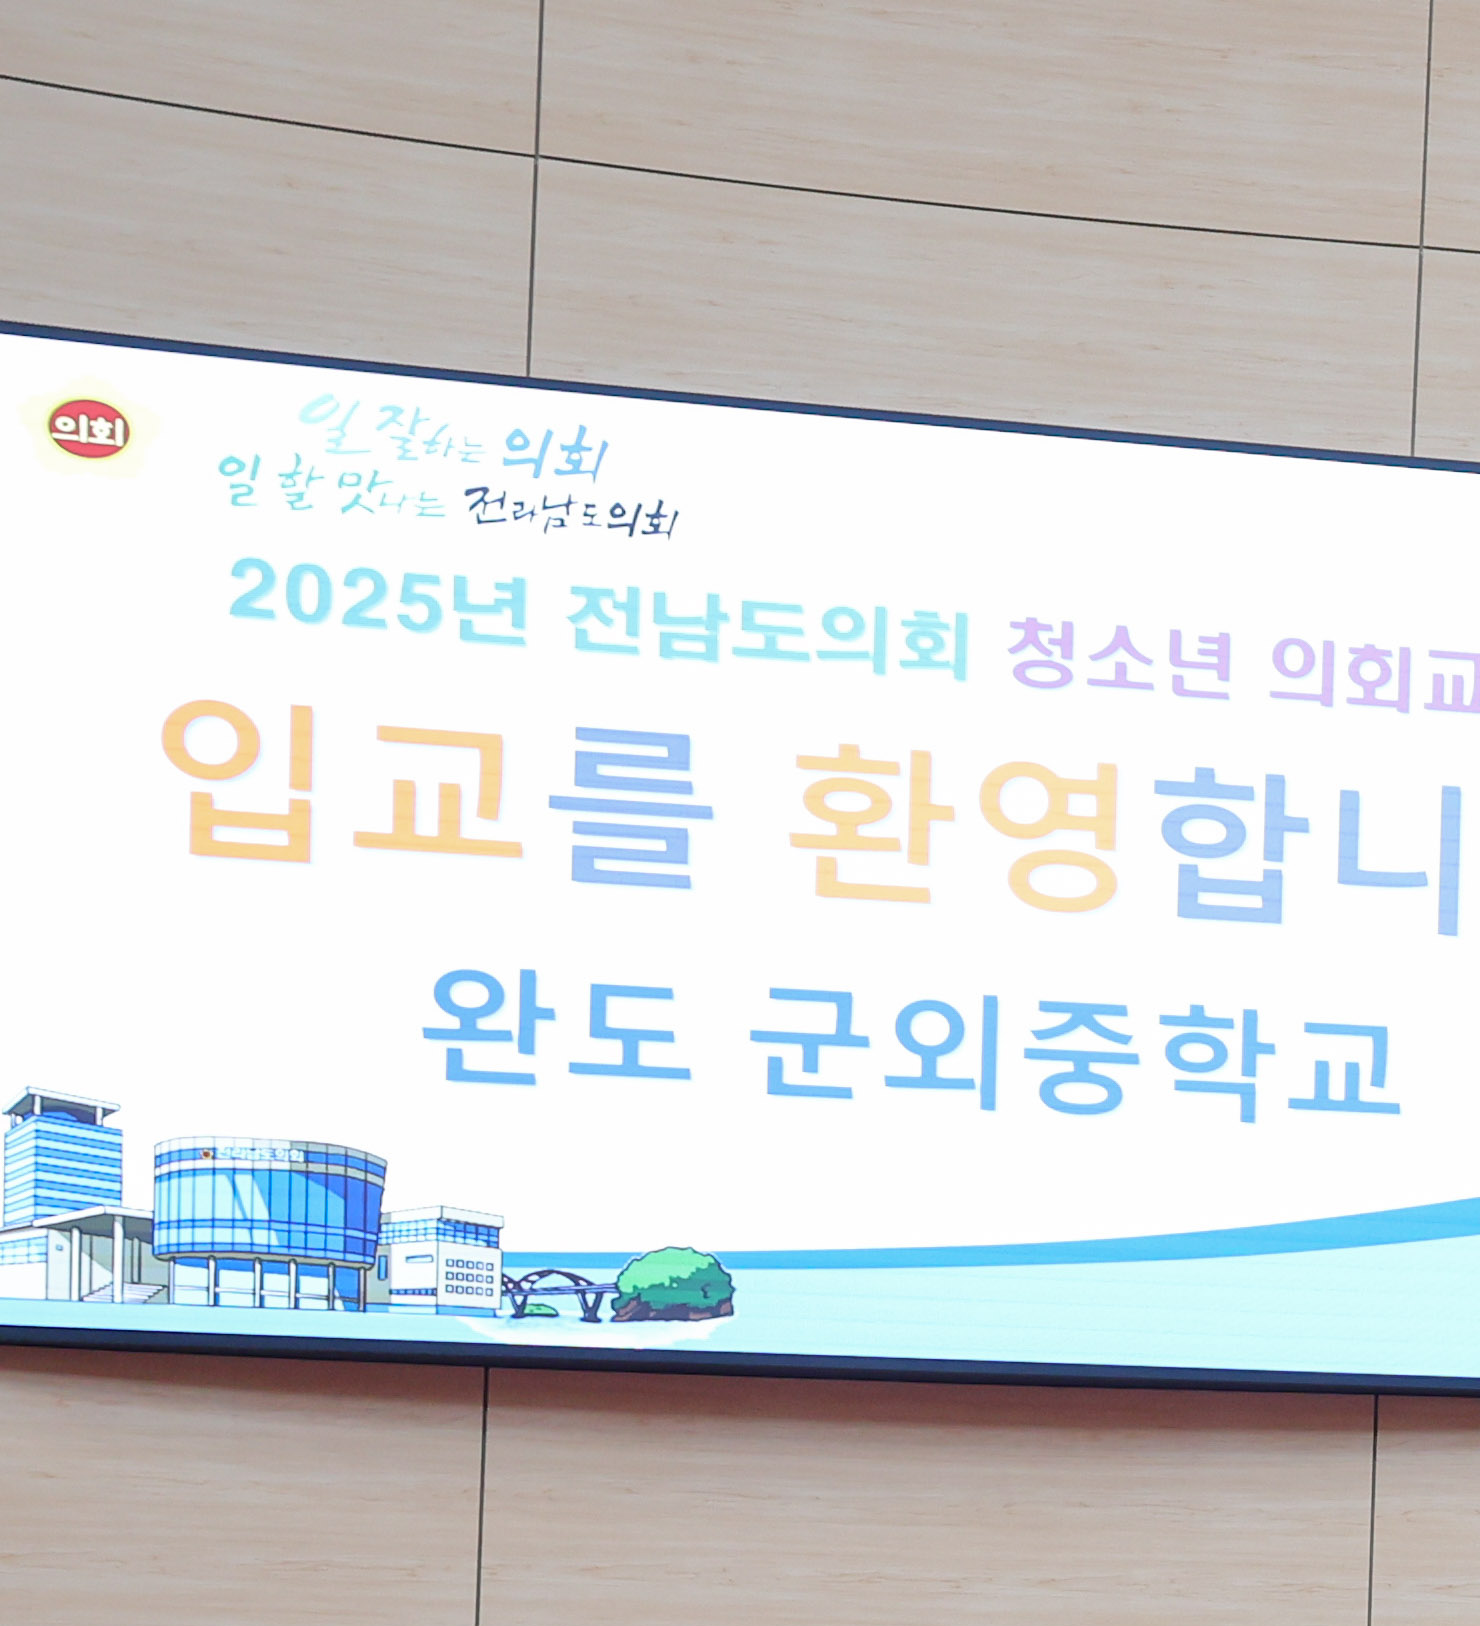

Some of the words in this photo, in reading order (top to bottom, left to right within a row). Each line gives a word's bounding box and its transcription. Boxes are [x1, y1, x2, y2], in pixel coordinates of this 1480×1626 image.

[50, 410, 127, 450] 의회
[298, 394, 371, 456] 일
[373, 404, 488, 464] 잘하는
[503, 424, 608, 483] 의회
[338, 468, 447, 518] 맛나는
[464, 480, 679, 540] 전라남도의회
[230, 557, 527, 647] 2025년
[566, 586, 968, 682] 전남도의회
[1008, 617, 1230, 700] 청소년
[162, 700, 714, 890] 입교를
[422, 969, 692, 1086] 완도
[750, 987, 1402, 1124] 군외중학교
